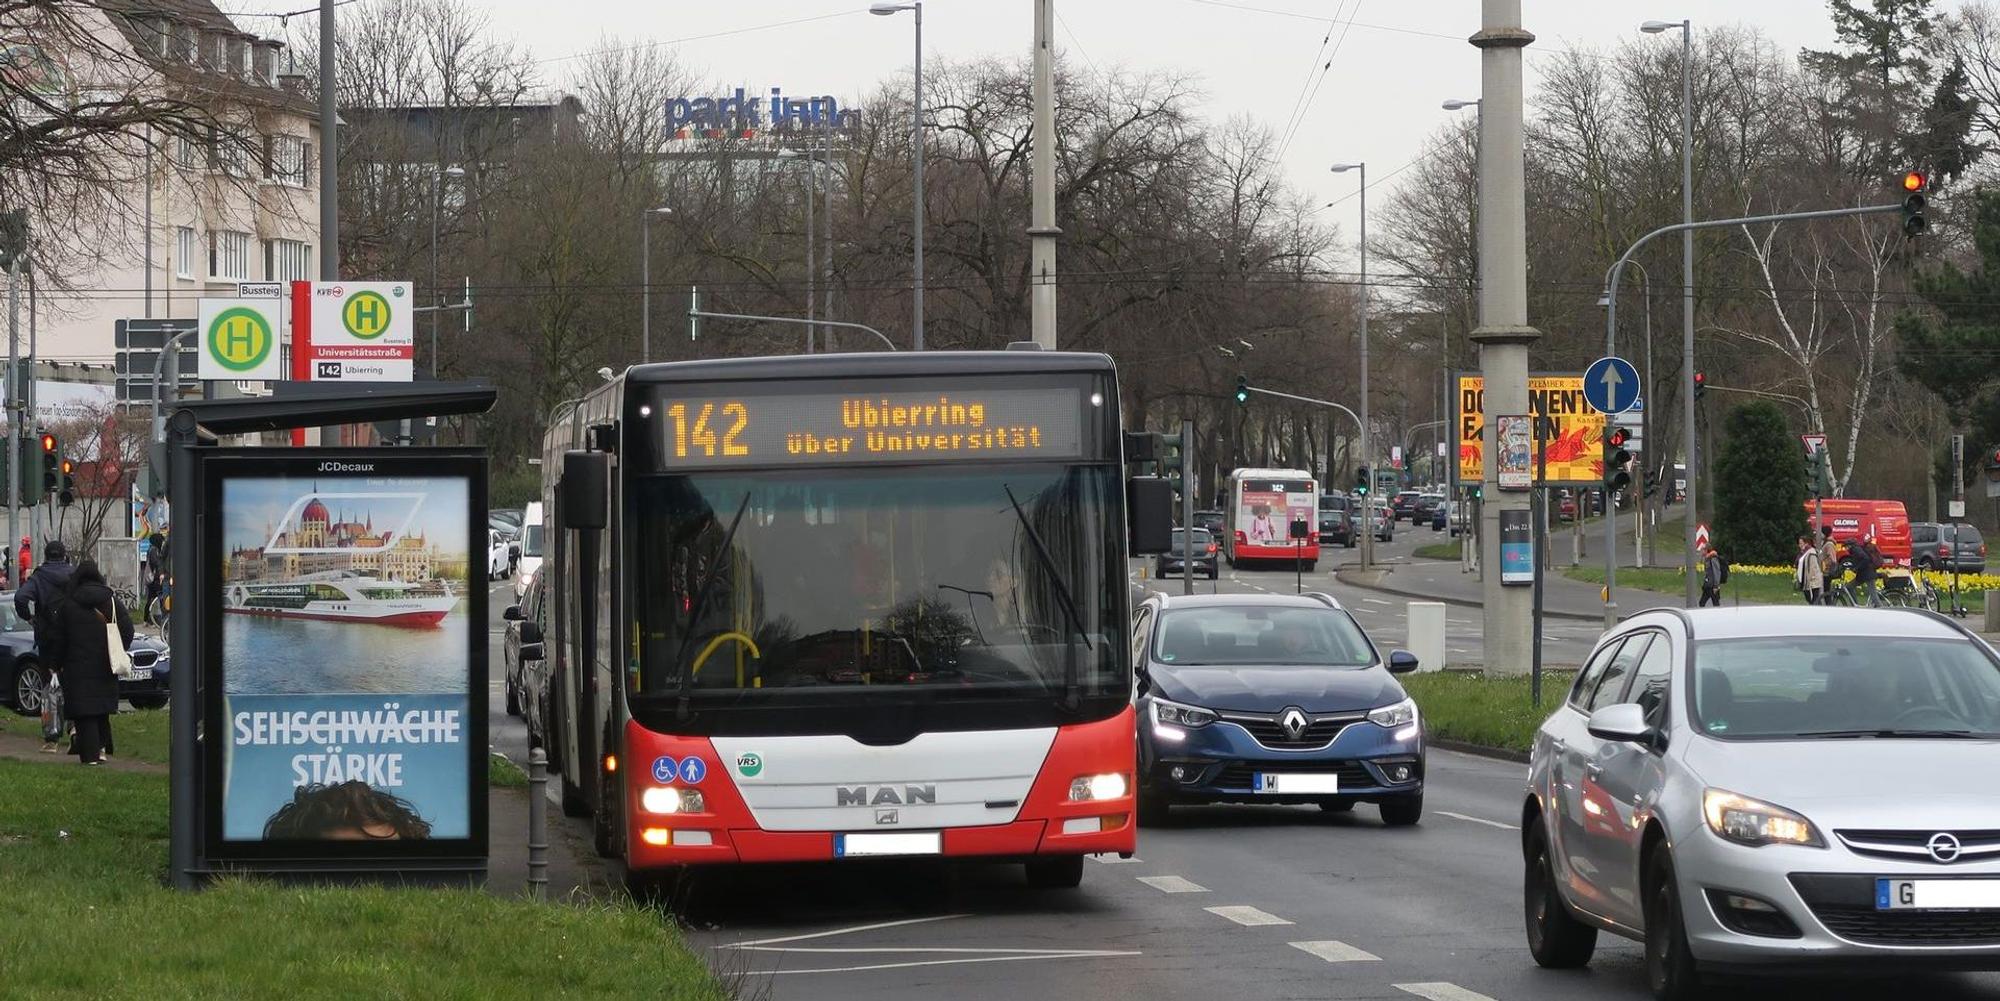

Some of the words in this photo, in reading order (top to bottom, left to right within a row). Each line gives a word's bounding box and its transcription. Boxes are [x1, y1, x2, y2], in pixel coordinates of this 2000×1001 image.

[665, 88, 759, 137] park
[771, 88, 837, 128] inn
[241, 286, 280, 297] Bussteig
[356, 300, 378, 330] H
[227, 321, 253, 357] H
[318, 348, 402, 357] Universitätsstraße
[319, 365, 340, 376] 142
[345, 366, 383, 376] Ubierring
[667, 402, 749, 457] 142
[843, 397, 985, 429] Ubierring
[786, 433, 854, 455] über
[867, 426, 1042, 453] Universität
[317, 461, 375, 472] JCDecaux
[234, 702, 460, 745] SEHSCHWÄCHE
[291, 746, 403, 787] STÄRKE
[737, 758, 756, 766] VRS
[836, 783, 936, 806] MAN
